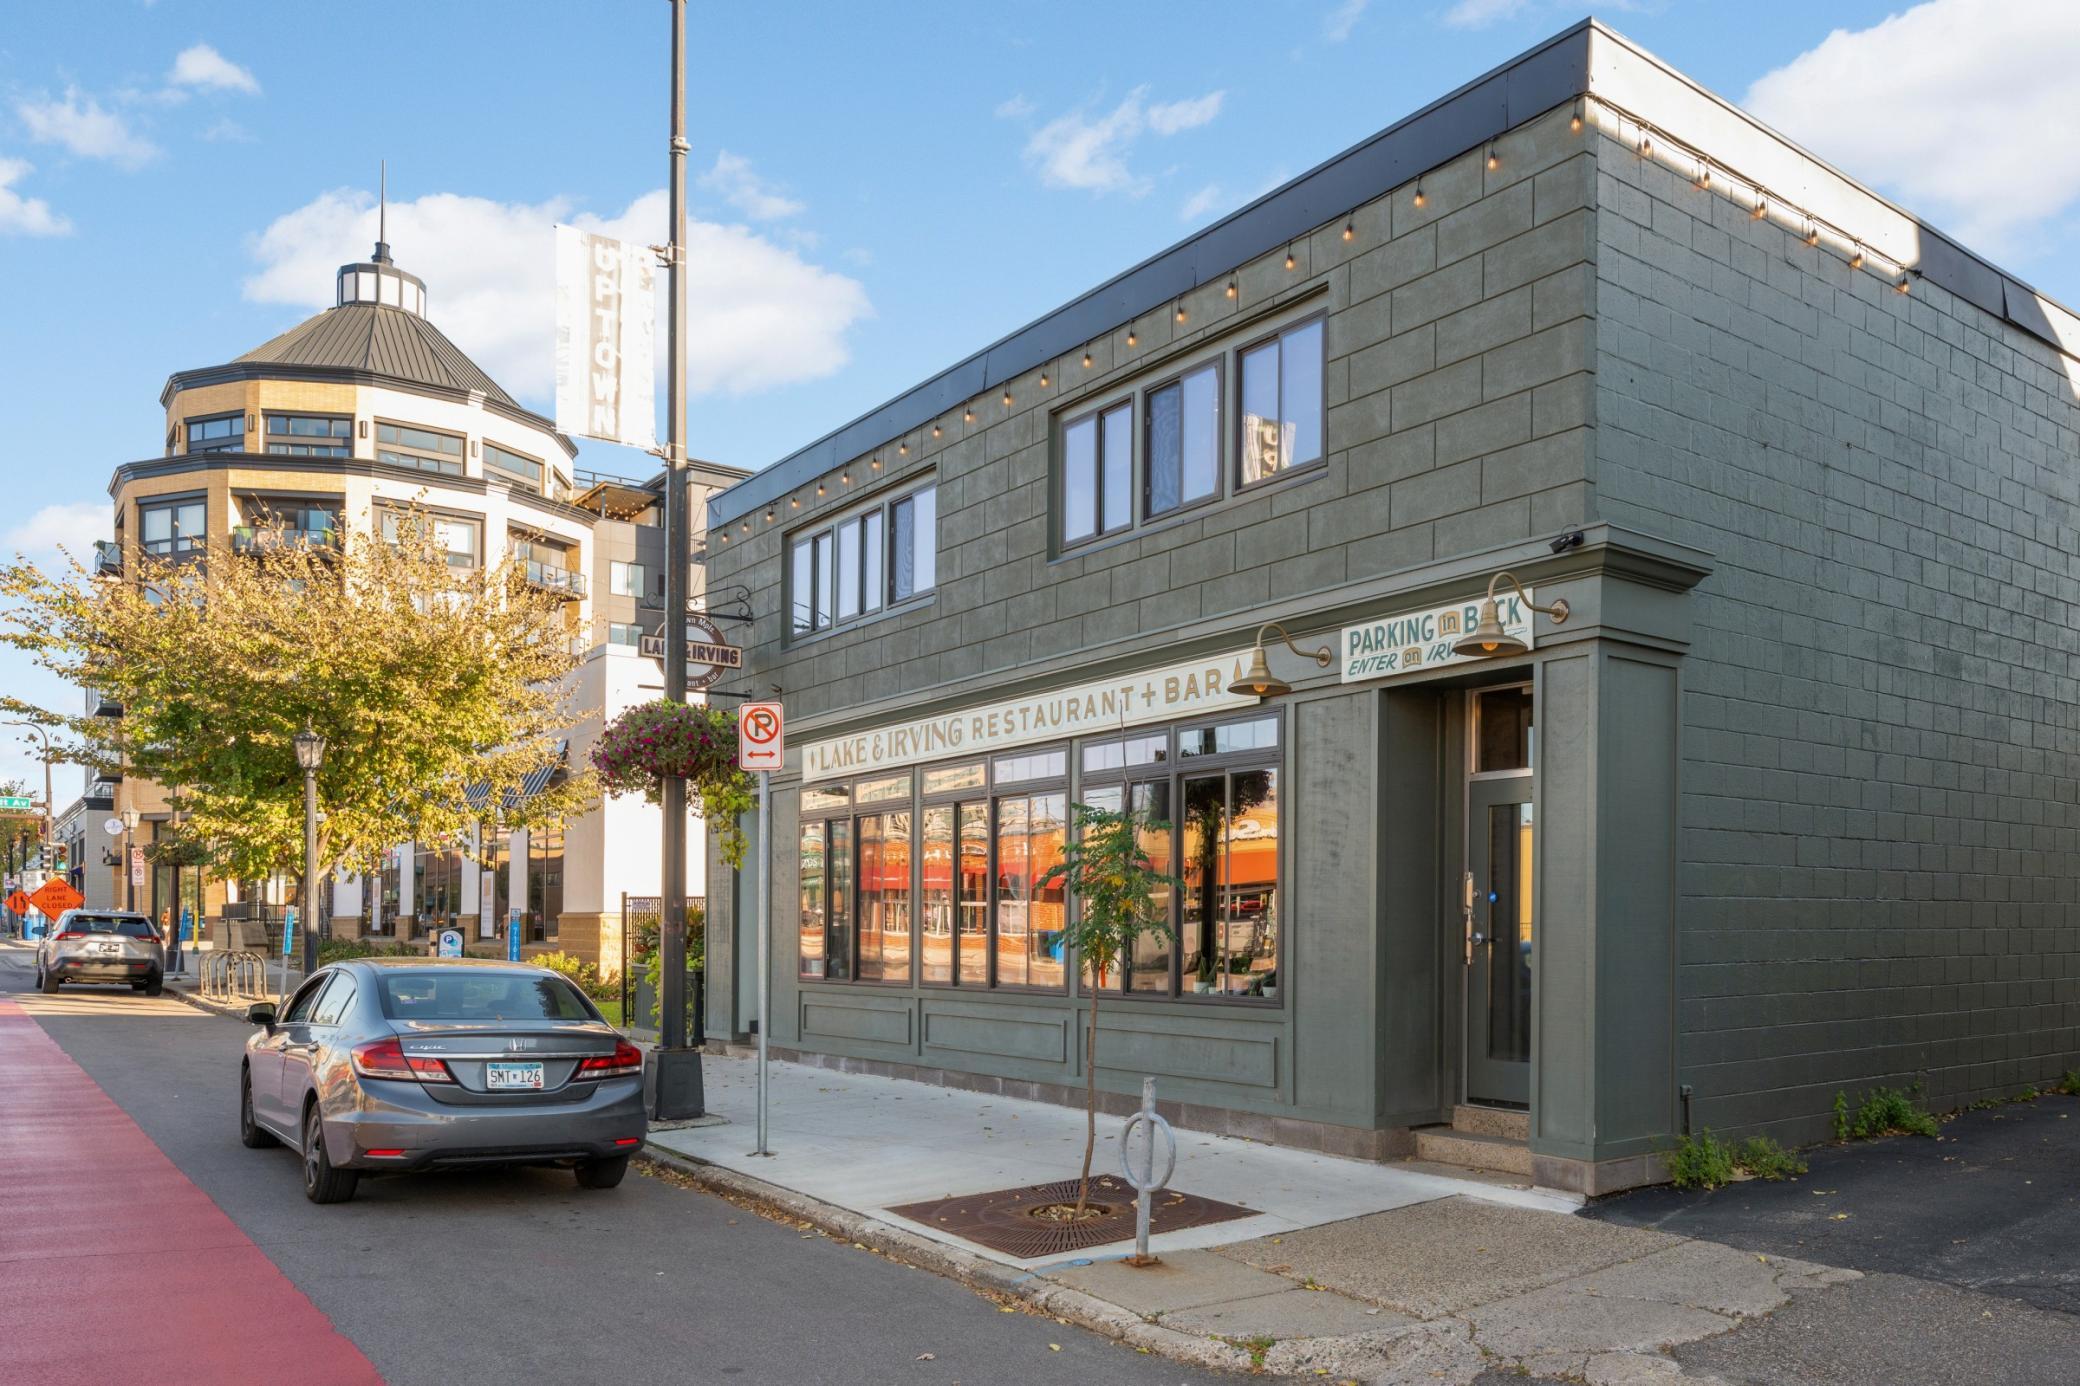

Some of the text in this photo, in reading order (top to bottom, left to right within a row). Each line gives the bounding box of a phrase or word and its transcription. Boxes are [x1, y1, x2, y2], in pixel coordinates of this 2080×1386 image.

[593, 243, 618, 435] UPTOWN
[1349, 614, 1434, 656] PARKING
[1464, 597, 1521, 634] BCK
[692, 644, 739, 665] IRVING
[1348, 653, 1397, 676] ENTER
[820, 737, 866, 771] LAKE
[872, 734, 883, 761] &
[888, 717, 962, 757] IRVING
[972, 686, 1134, 740] RESTAURANT
[1165, 669, 1221, 704] BAR
[520, 1070, 540, 1083] 126
